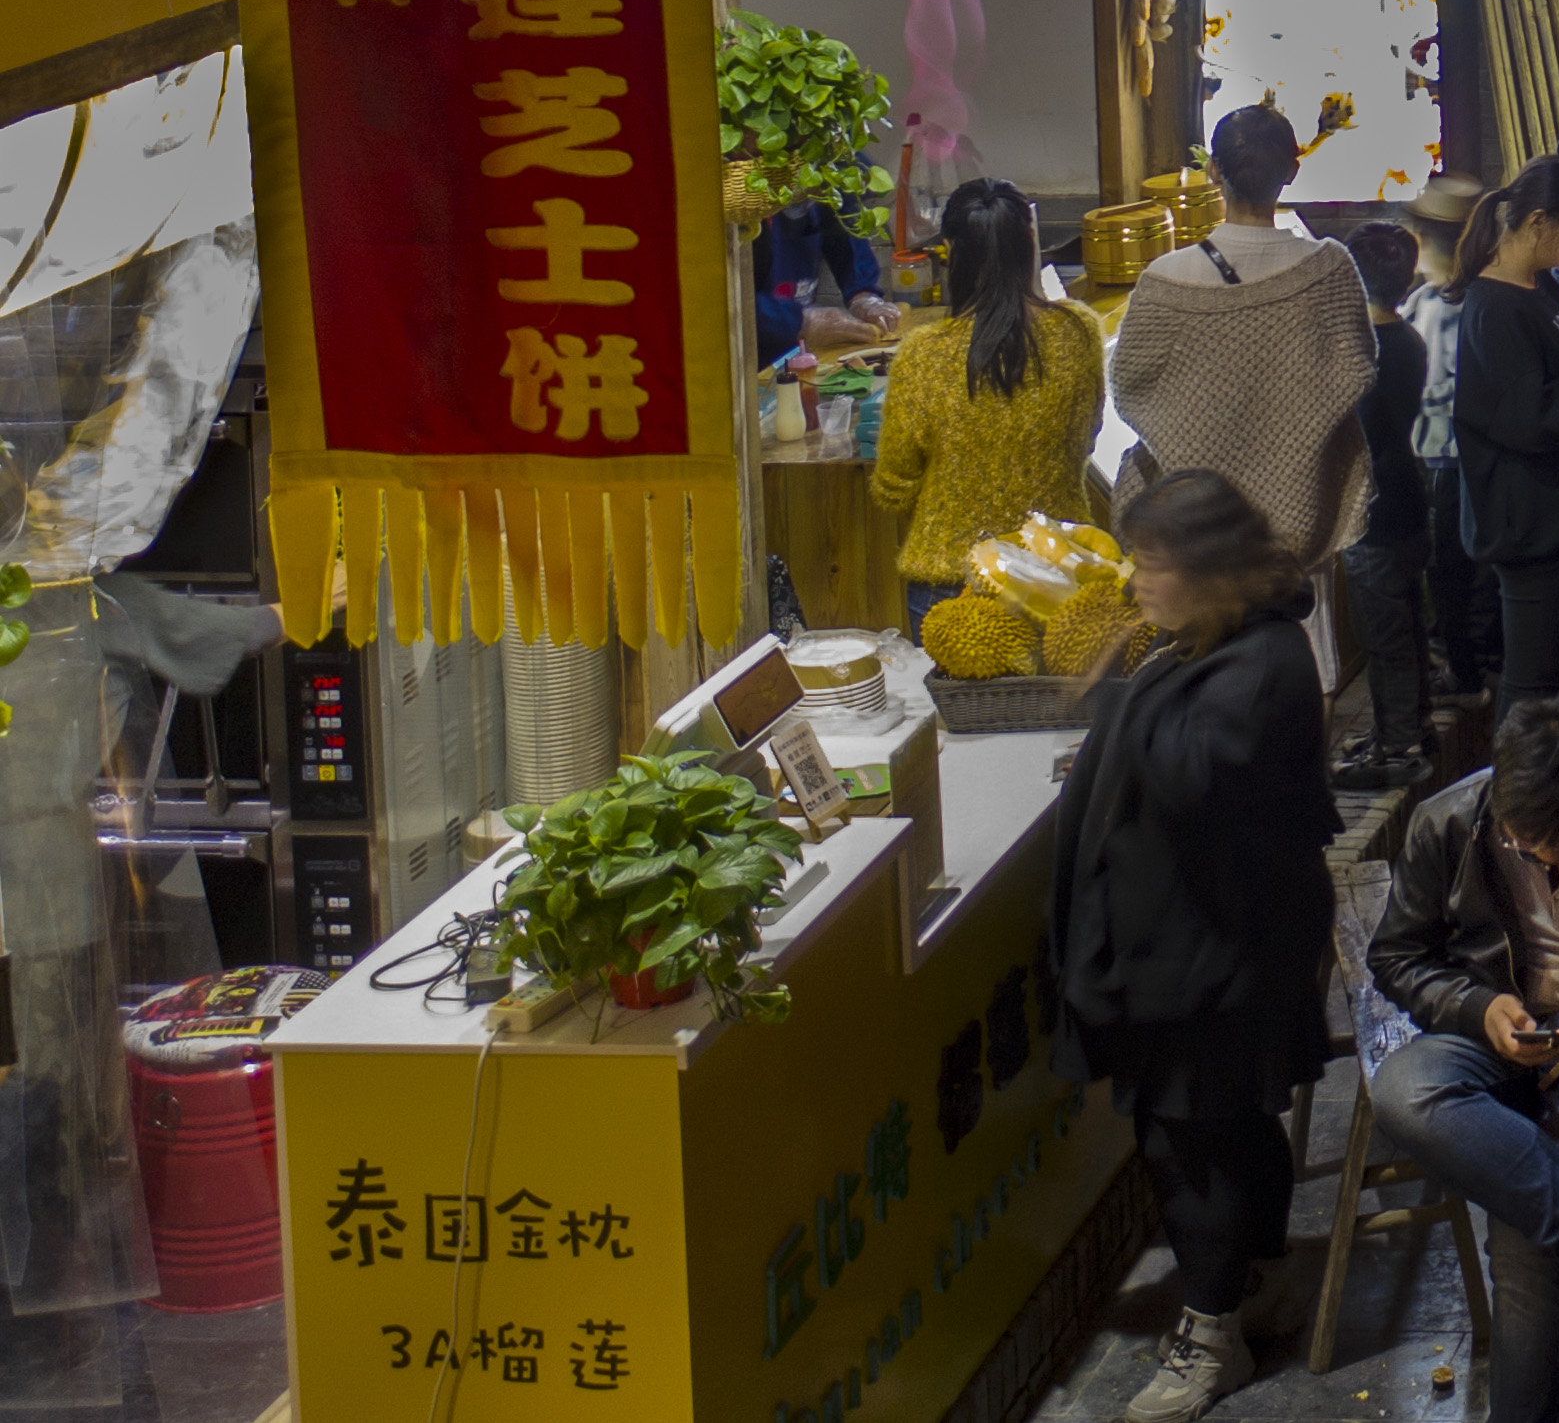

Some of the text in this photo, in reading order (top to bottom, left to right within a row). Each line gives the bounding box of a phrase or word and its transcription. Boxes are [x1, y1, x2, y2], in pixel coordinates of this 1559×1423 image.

[327, 1157, 633, 1267] 泰国金枕
[763, 1098, 912, 1361] 丘比特
